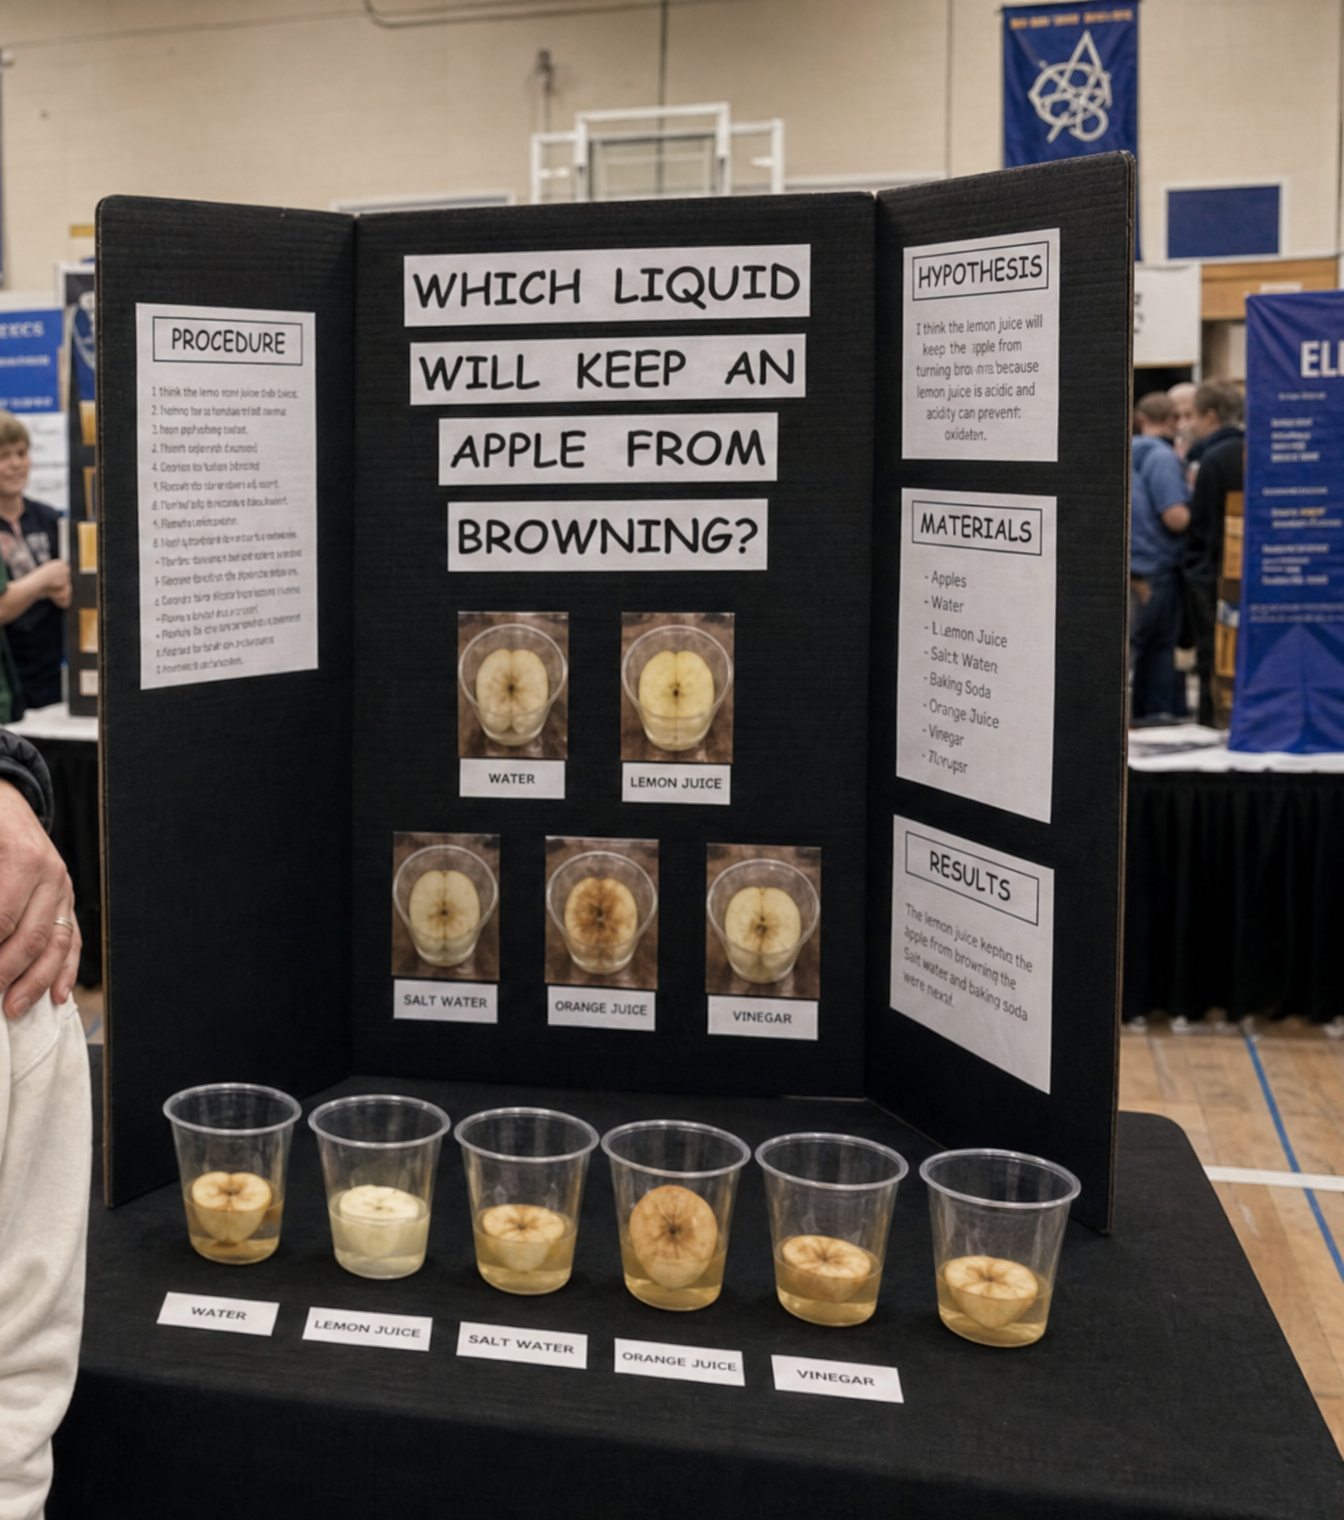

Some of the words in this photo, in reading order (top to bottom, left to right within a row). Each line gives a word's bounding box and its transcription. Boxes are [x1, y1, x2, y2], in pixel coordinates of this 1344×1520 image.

[917, 254, 1043, 289] HYPOTHESIS
[412, 268, 581, 309] WHICH
[614, 263, 800, 310] LIQUID
[916, 322, 921, 335] I
[923, 321, 946, 335] think
[949, 320, 964, 334] the
[966, 320, 996, 332] lemon
[998, 316, 1022, 334] juice
[1025, 314, 1042, 328] will
[171, 327, 286, 354] PROCEDURE
[922, 342, 946, 358] keep
[950, 341, 966, 354] the
[998, 338, 1022, 352] from
[419, 354, 540, 391] WILL
[577, 349, 686, 389] KEEP
[724, 348, 795, 386] AN
[916, 363, 950, 380] turning
[996, 360, 1039, 374] because
[916, 385, 944, 398] lemon
[948, 384, 972, 401] juice
[974, 384, 982, 398] is
[985, 382, 1014, 397] acidic
[1016, 382, 1036, 396] and
[958, 408, 975, 420] can
[450, 430, 587, 468] APPLE
[627, 429, 766, 467] FROM
[458, 517, 758, 555] BROWNING?
[920, 512, 1032, 543] MATERIALS
[930, 570, 967, 589] Apples
[931, 595, 964, 613] Water
[976, 630, 1008, 648] Juice
[930, 672, 963, 696] Baking
[965, 680, 992, 699] Soda
[930, 698, 966, 722] Orange
[969, 709, 1000, 729] Juice
[928, 724, 964, 748] Vinegar
[488, 773, 536, 785] WATER
[630, 776, 678, 789] LEMON
[681, 777, 723, 790] JUICE
[929, 850, 1012, 901] RESULTS
[906, 902, 923, 922] The
[924, 912, 953, 936] lemon
[954, 926, 978, 948] juice
[1016, 955, 1033, 974] the
[904, 926, 928, 947] apple
[930, 936, 953, 958] from
[1000, 972, 1017, 990] the
[902, 972, 926, 991] were
[404, 994, 436, 1007] SALT
[439, 996, 488, 1009] WATER
[950, 972, 967, 991] and
[968, 980, 1001, 1010] baking
[1002, 1000, 1028, 1022] soda
[555, 1001, 608, 1015] ORANGE
[610, 1003, 648, 1016] JUICE
[732, 1011, 793, 1025] VINEGAR
[190, 1306, 248, 1320] WATER
[314, 1320, 371, 1334] LEMON
[374, 1325, 422, 1338] JUICE
[468, 1334, 511, 1347] SALT
[516, 1340, 575, 1355] WATER
[622, 1351, 687, 1368] ORANGE
[691, 1358, 738, 1372] JUICE
[796, 1369, 876, 1387] VINEGAR
